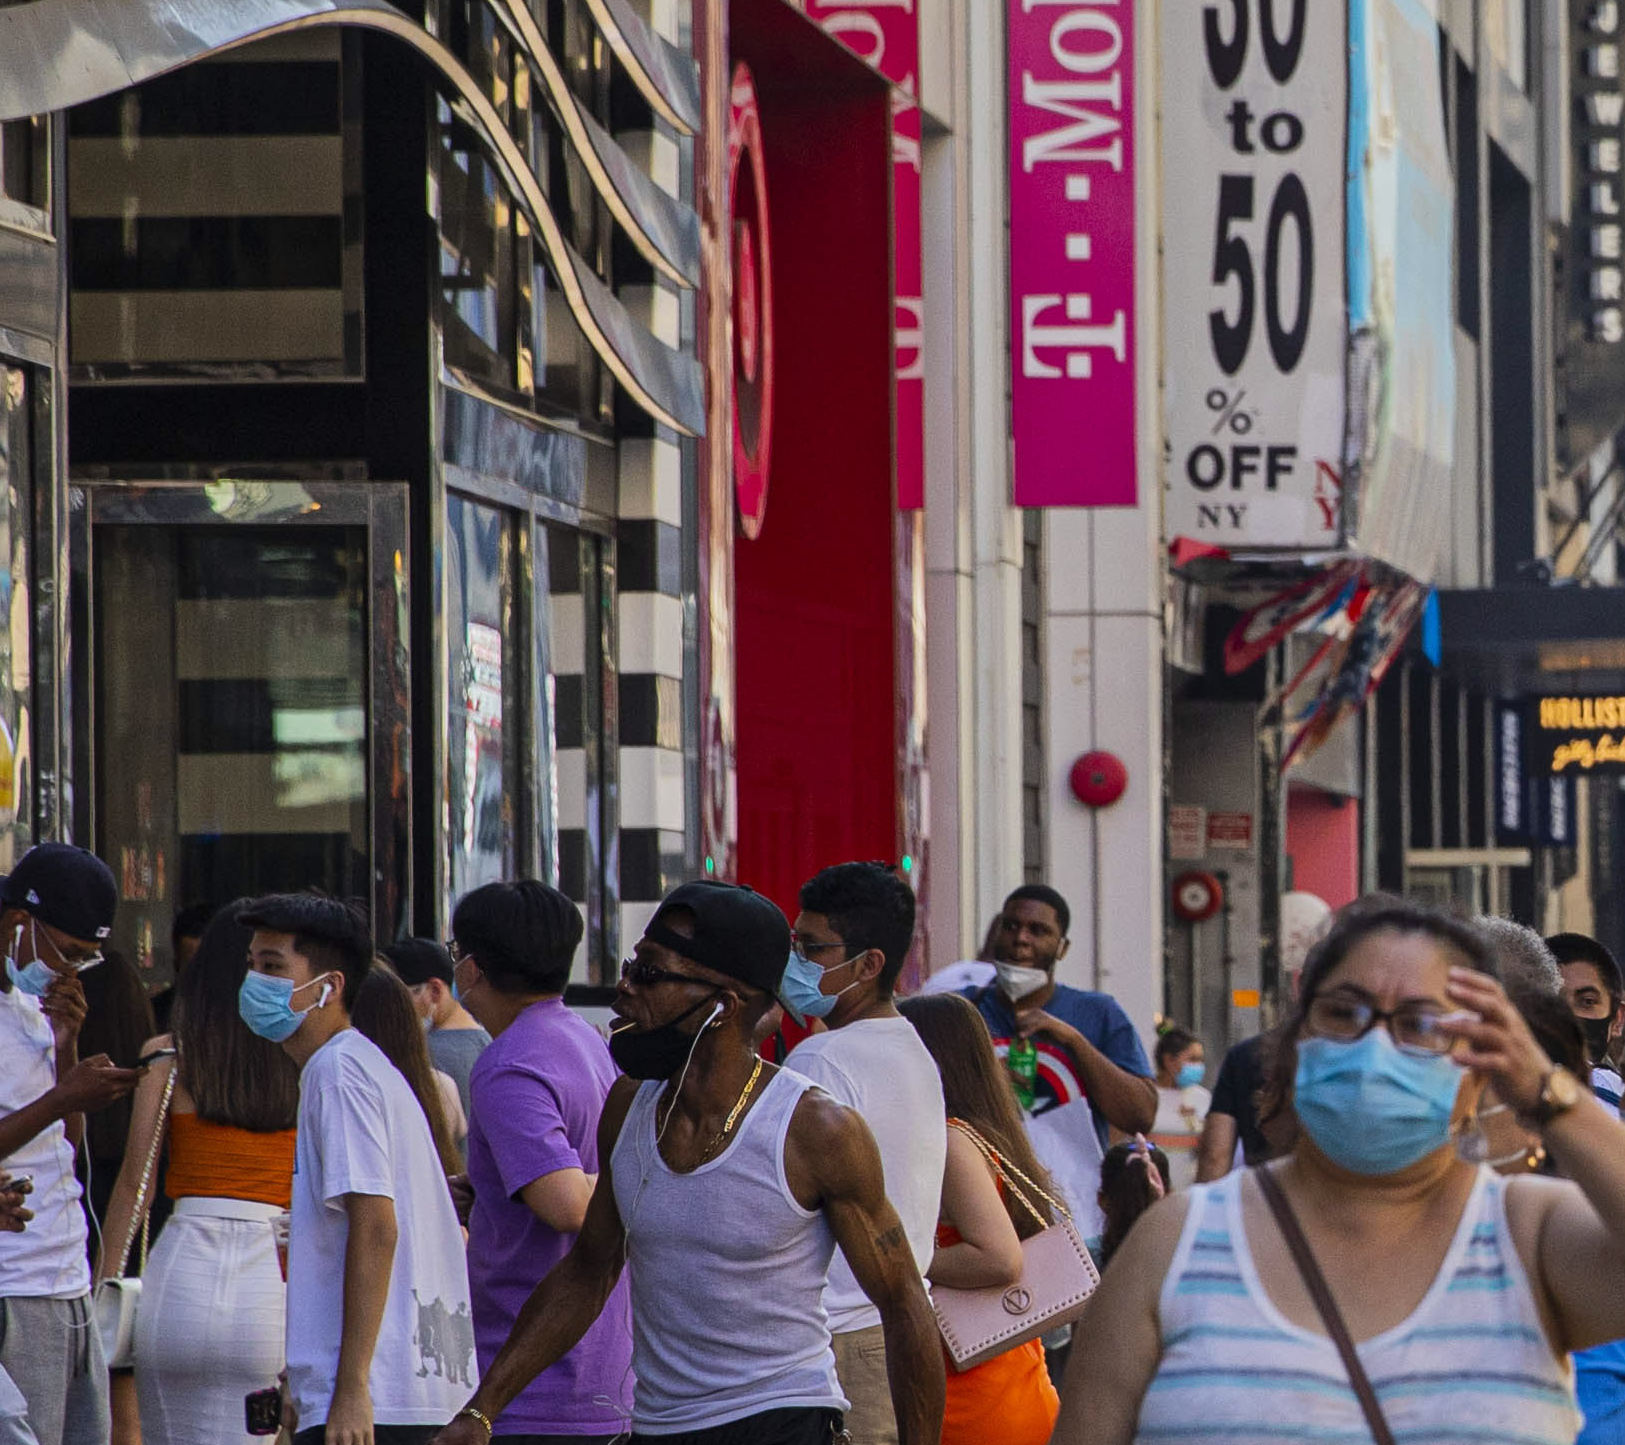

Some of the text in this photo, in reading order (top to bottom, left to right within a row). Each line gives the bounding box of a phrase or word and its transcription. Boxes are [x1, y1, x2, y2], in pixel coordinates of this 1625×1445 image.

[1226, 102, 1304, 154] to
[1588, 0, 1624, 342] JEWELERS
[1208, 172, 1313, 376] 50
[1204, 387, 1253, 435] %
[1187, 444, 1297, 491] OFF
[1197, 505, 1247, 528] NY
